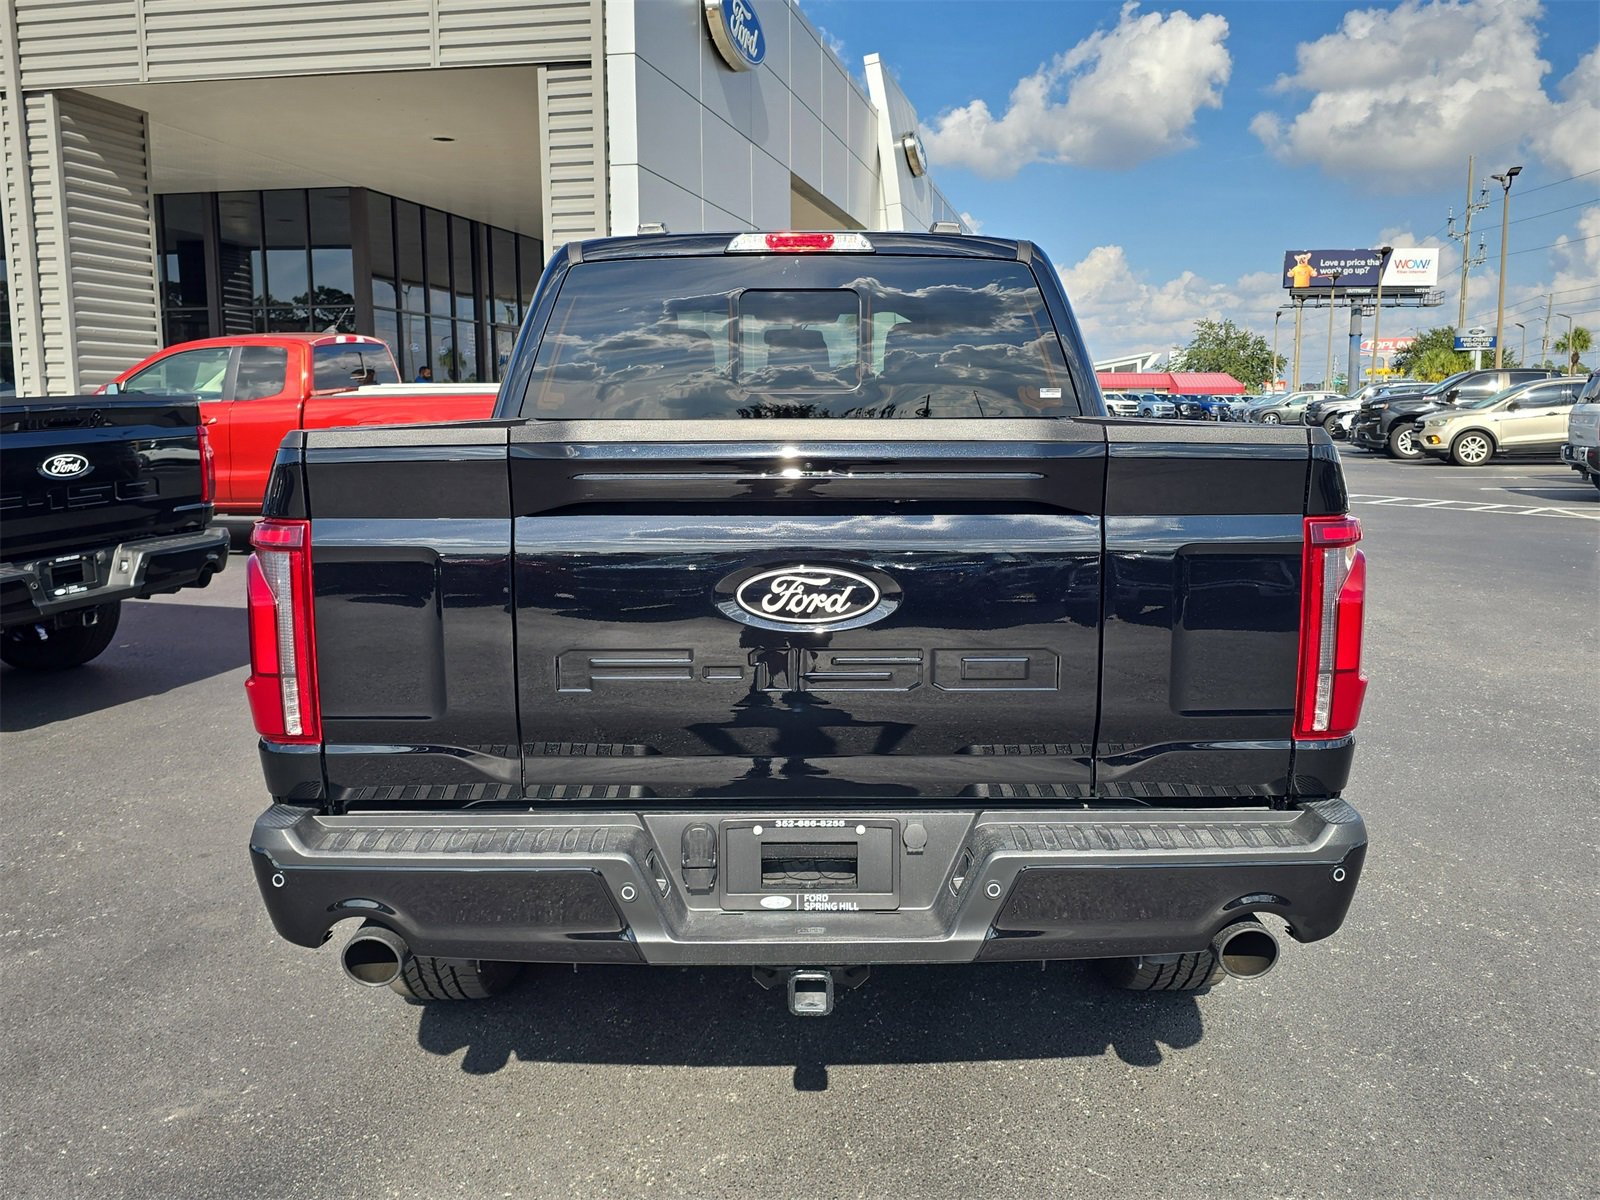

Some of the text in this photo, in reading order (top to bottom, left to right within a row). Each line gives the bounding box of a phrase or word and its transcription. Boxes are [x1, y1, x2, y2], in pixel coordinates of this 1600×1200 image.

[731, 0, 759, 58] Ford
[1320, 259, 1338, 267] Love
[1346, 259, 1366, 268] price
[1394, 259, 1431, 269] WOW!
[1320, 266, 1342, 274] won't
[1354, 266, 1370, 275] up?
[51, 457, 81, 474] Ford
[761, 575, 857, 613] Ford
[556, 647, 1060, 692] F-150
[804, 894, 828, 902] FORD
[804, 902, 859, 911] SPRING HILL
